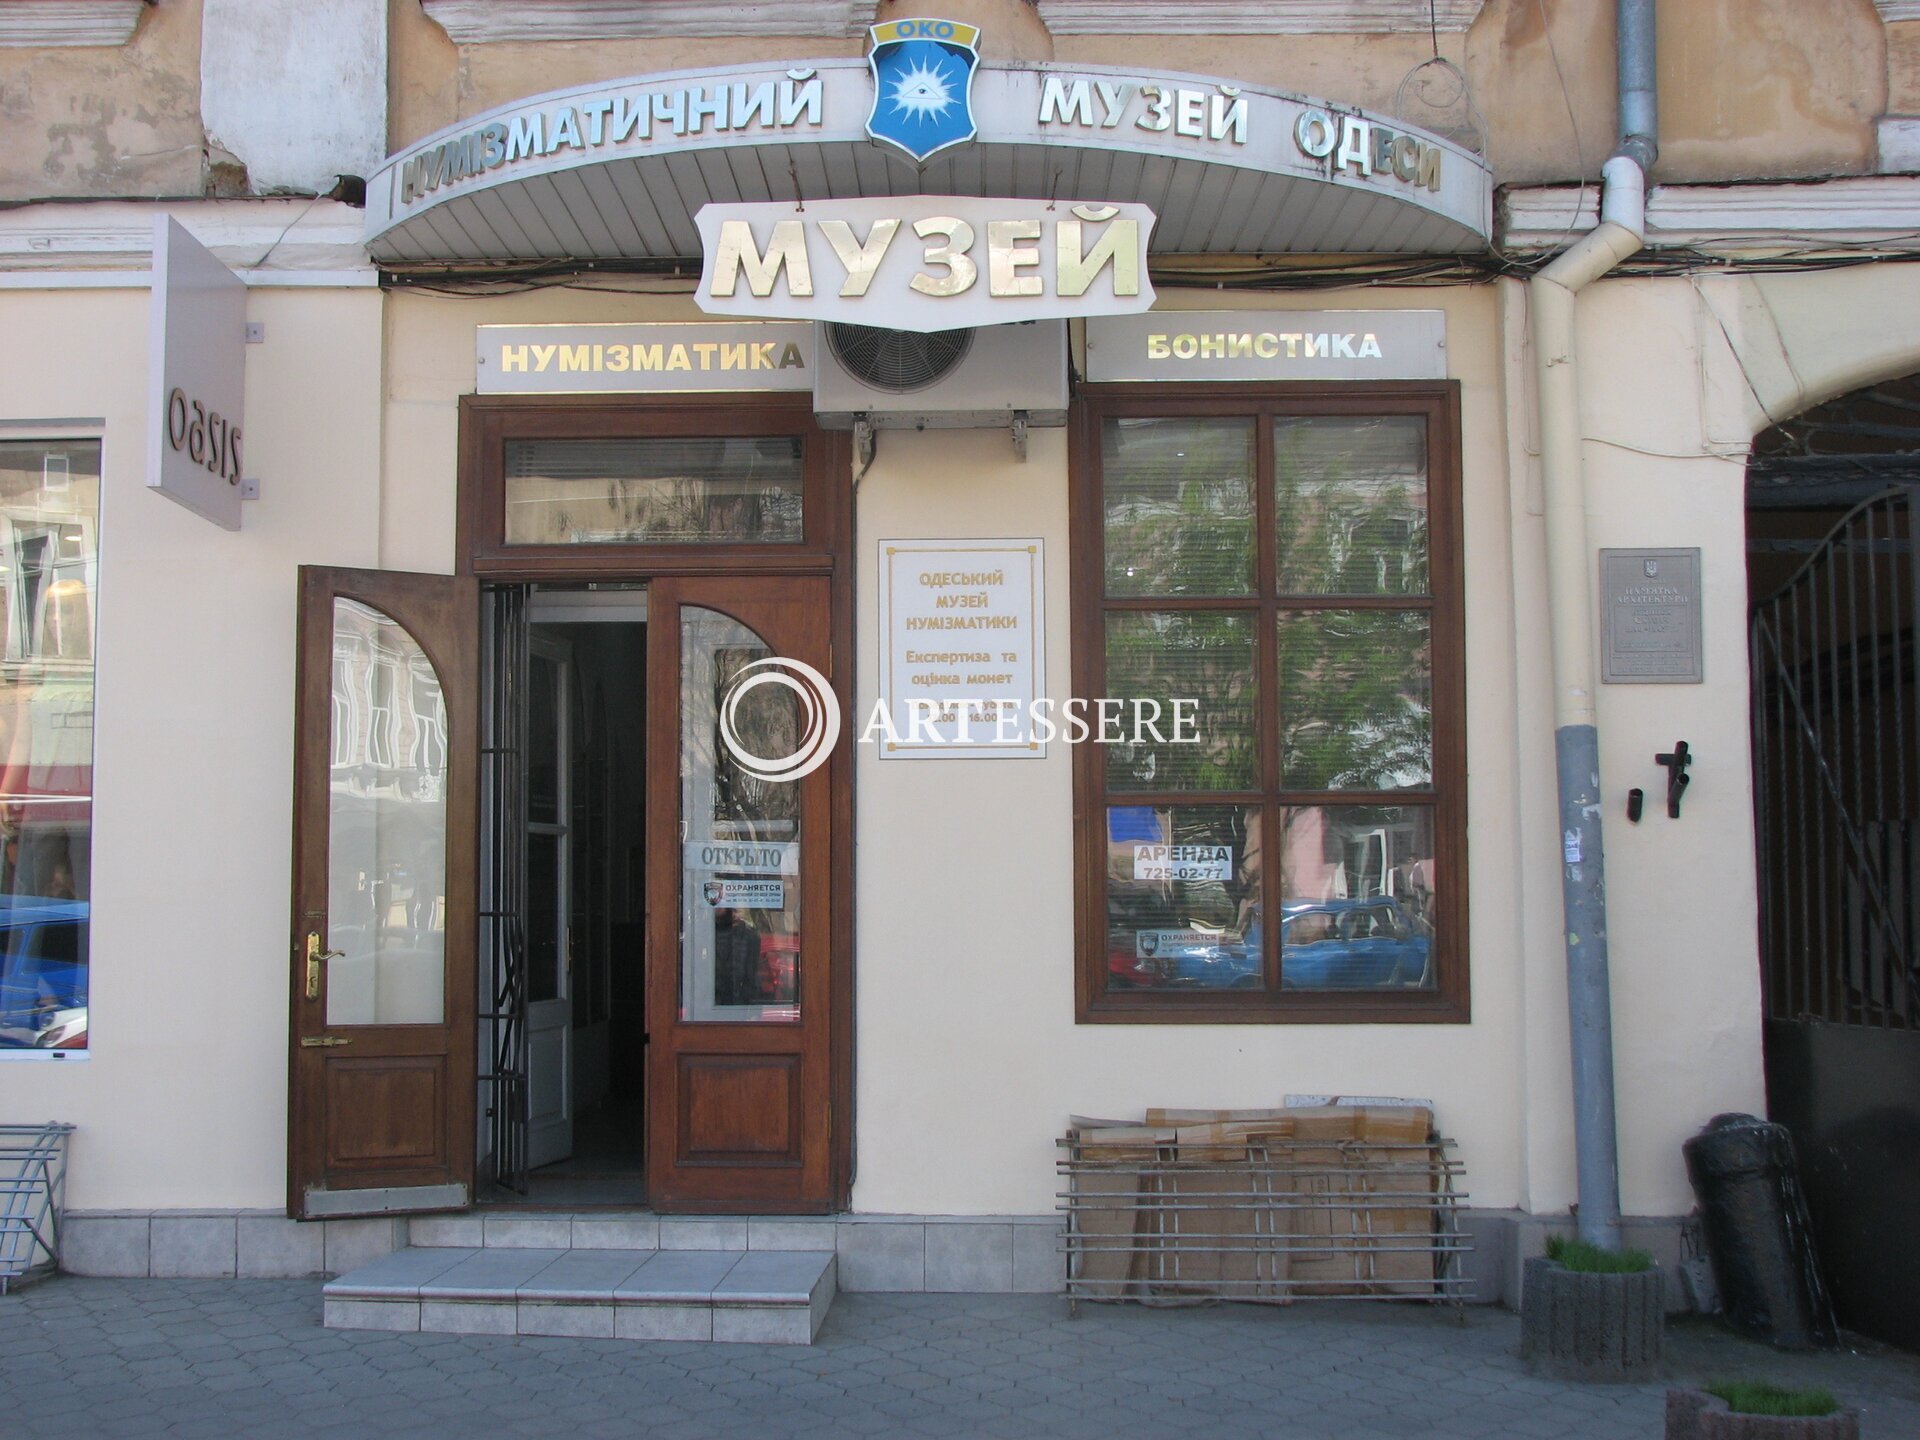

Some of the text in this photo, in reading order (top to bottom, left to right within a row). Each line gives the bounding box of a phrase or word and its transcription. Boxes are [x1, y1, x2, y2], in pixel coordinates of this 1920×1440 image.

[896, 19, 954, 40] ОКО
[400, 67, 1442, 205] НУМІЗМАТИЧНИЙ МУЗЕЙ ОДЕСИ
[710, 204, 1139, 298] МУЗЕЙ
[1146, 332, 1383, 361] БОНИСТИКА
[501, 341, 805, 374] НУМІЗМАТИКА
[919, 569, 1004, 588] ОДЕСЬКИЙ
[936, 592, 989, 608] МУЗЕЙ
[906, 616, 1018, 631] НУМІЗМАТИКИ
[906, 650, 1017, 666] Експертиза та
[911, 673, 1013, 688] оцінка монет
[701, 846, 782, 868] ОТКРЫТО
[1137, 846, 1230, 864] АРЕНДА
[1143, 867, 1224, 879] 725-02-77
[725, 884, 781, 892] ОХРАНЯЕТСЯ
[1160, 934, 1217, 942] ОХРАНЯЕТСЯ
